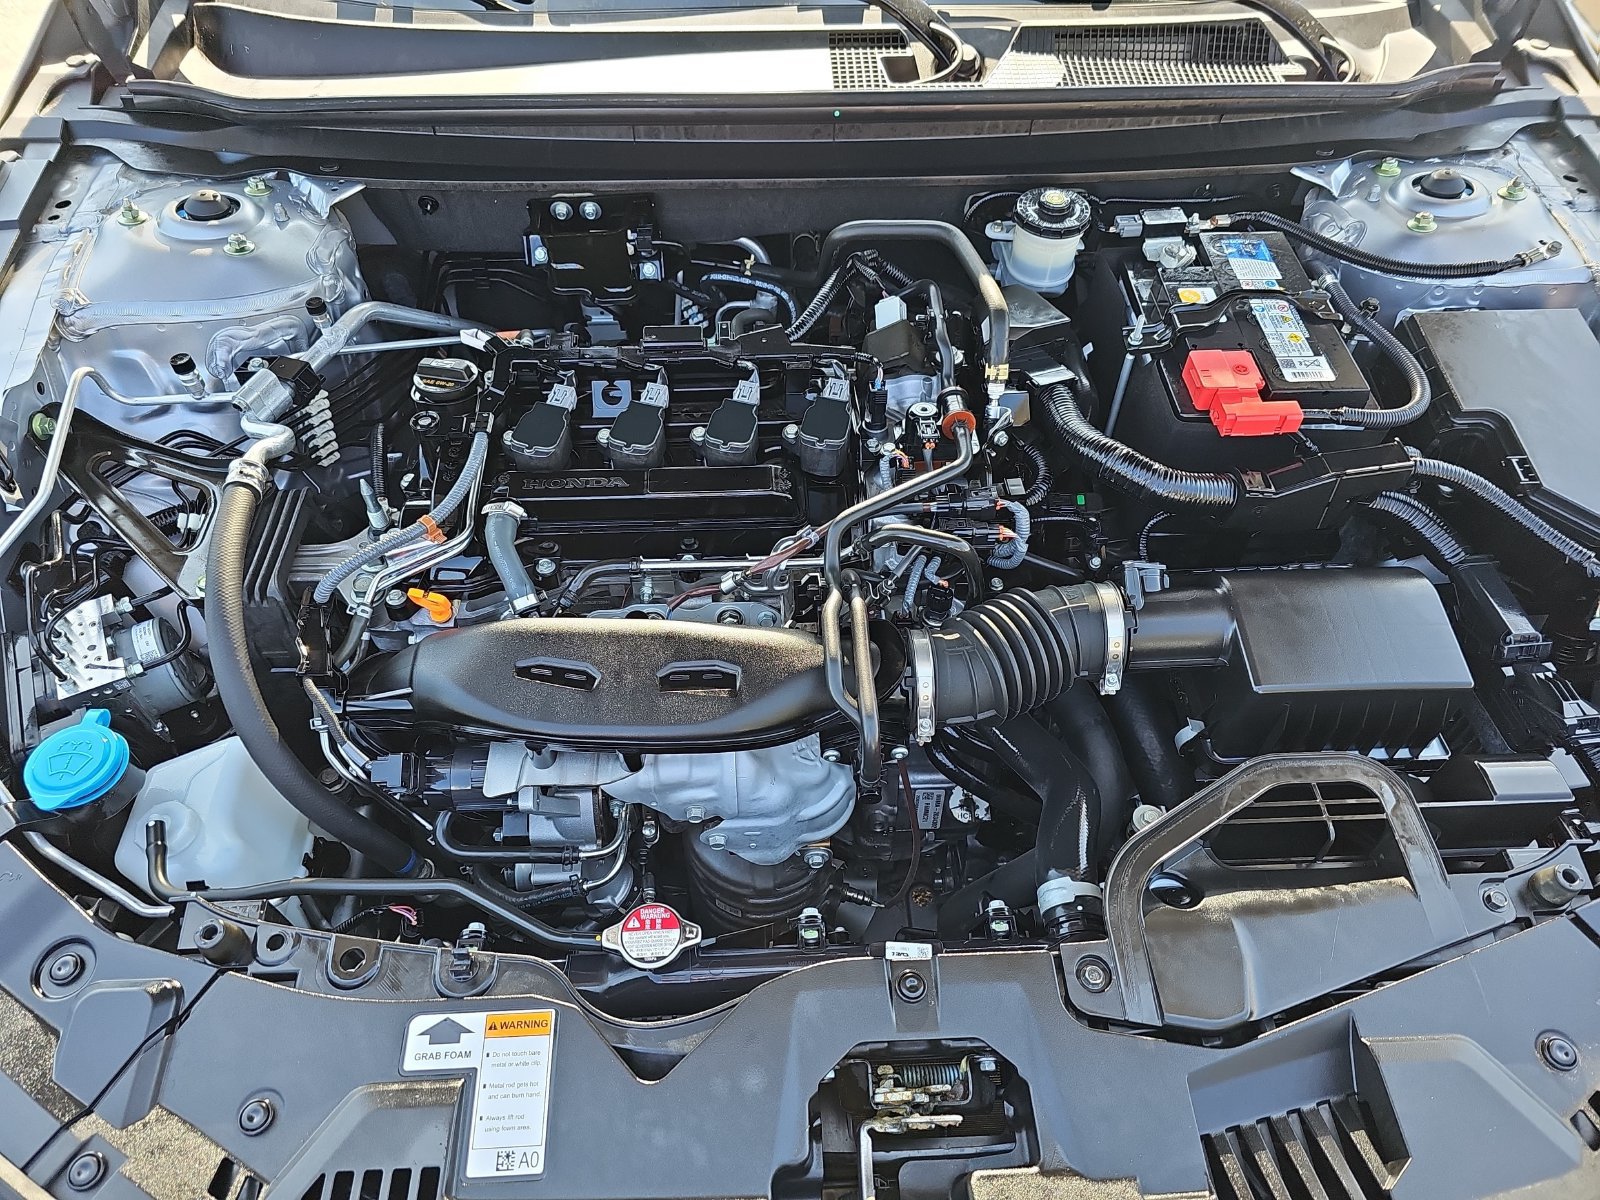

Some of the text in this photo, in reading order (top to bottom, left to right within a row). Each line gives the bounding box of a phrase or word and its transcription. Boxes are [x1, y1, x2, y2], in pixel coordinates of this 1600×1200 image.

[522, 477, 630, 489] HONDA
[500, 1019, 549, 1030] WARNING
[414, 1050, 472, 1061] GRAB FOAM
[518, 1151, 540, 1169] A0
